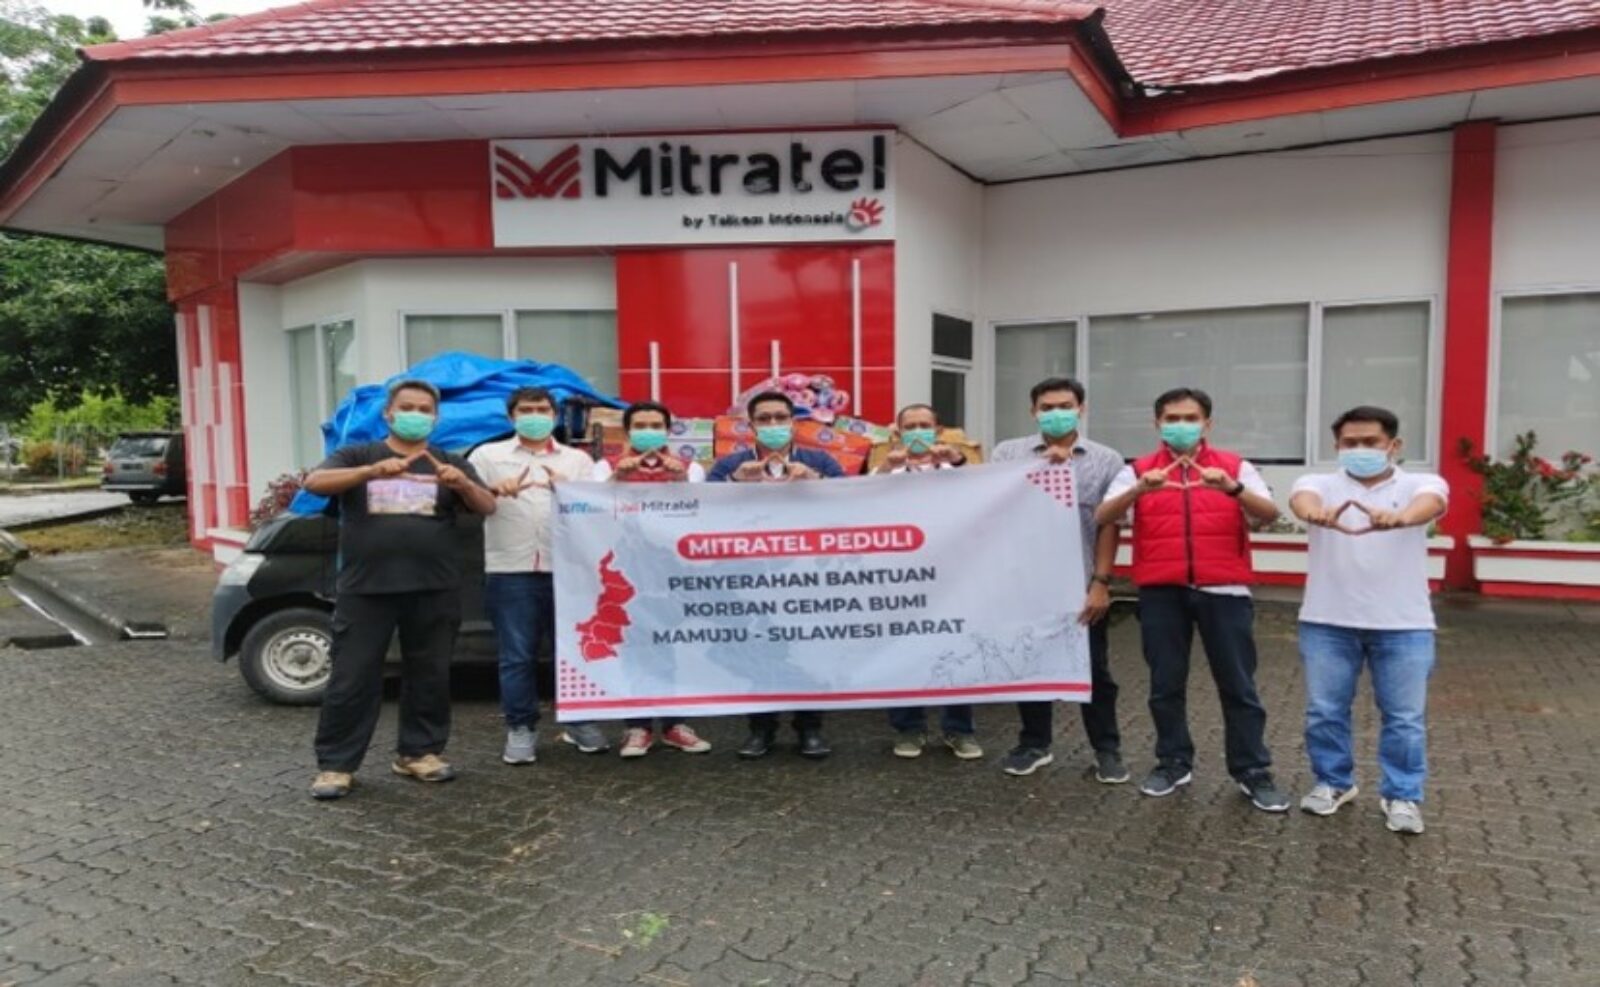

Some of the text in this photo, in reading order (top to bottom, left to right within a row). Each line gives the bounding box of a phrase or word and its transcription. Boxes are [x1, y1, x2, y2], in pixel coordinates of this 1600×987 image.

[594, 135, 886, 197] Mitratel
[683, 213, 843, 229] by Telkom Indonesia
[641, 499, 699, 512] Mitratel
[689, 529, 913, 556] MITRATEL PEDULI
[668, 566, 936, 592] PENYERAHAN BANTUAN
[683, 594, 928, 618] KORBAN GEMPA BUMI
[652, 629, 748, 646] MAMUJU
[768, 622, 884, 643] SULAWESI
[892, 619, 966, 637] BARAT
